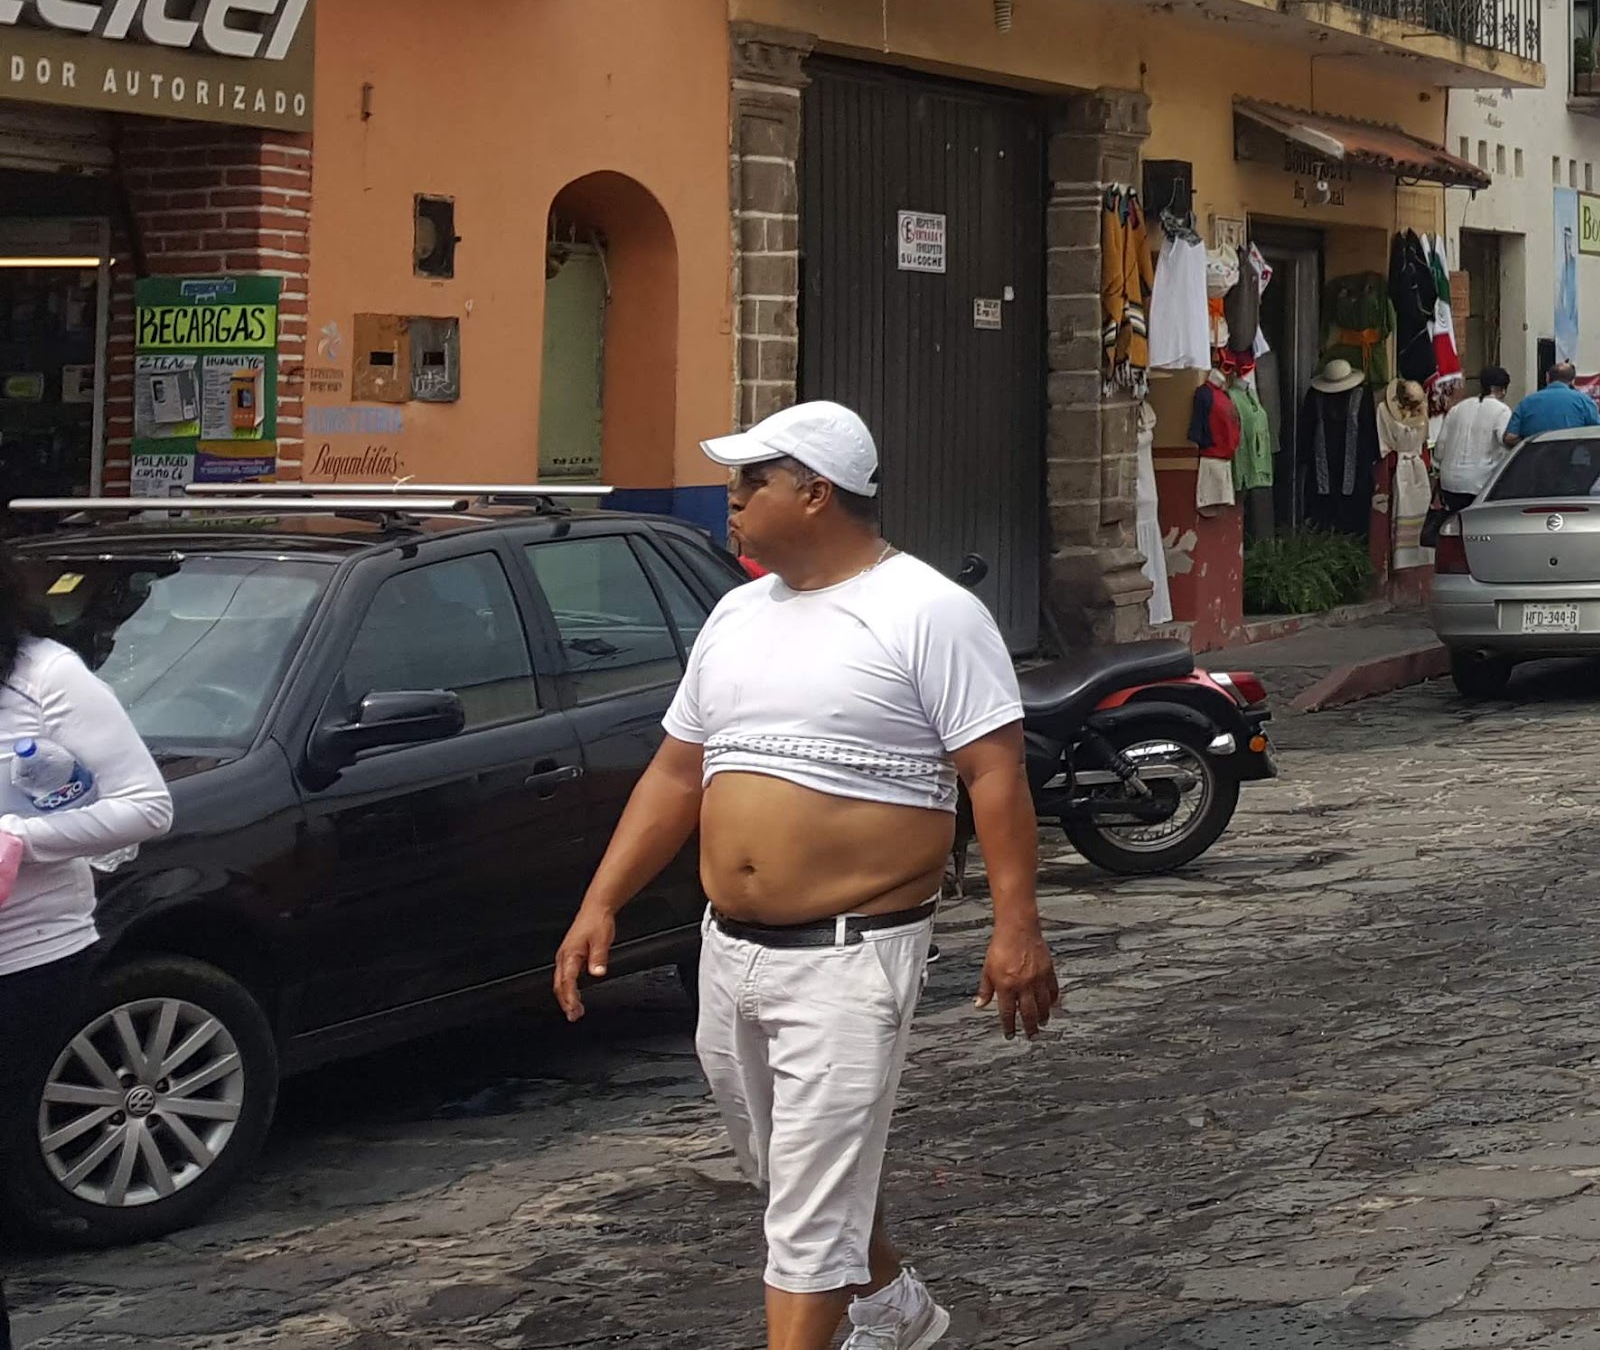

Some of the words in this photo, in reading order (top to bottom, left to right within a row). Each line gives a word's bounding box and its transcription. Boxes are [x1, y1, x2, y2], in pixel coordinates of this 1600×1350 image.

[102, 67, 306, 117] AUTORIZADO
[917, 255, 943, 267] COCHE
[138, 306, 266, 344] RECARGAS
